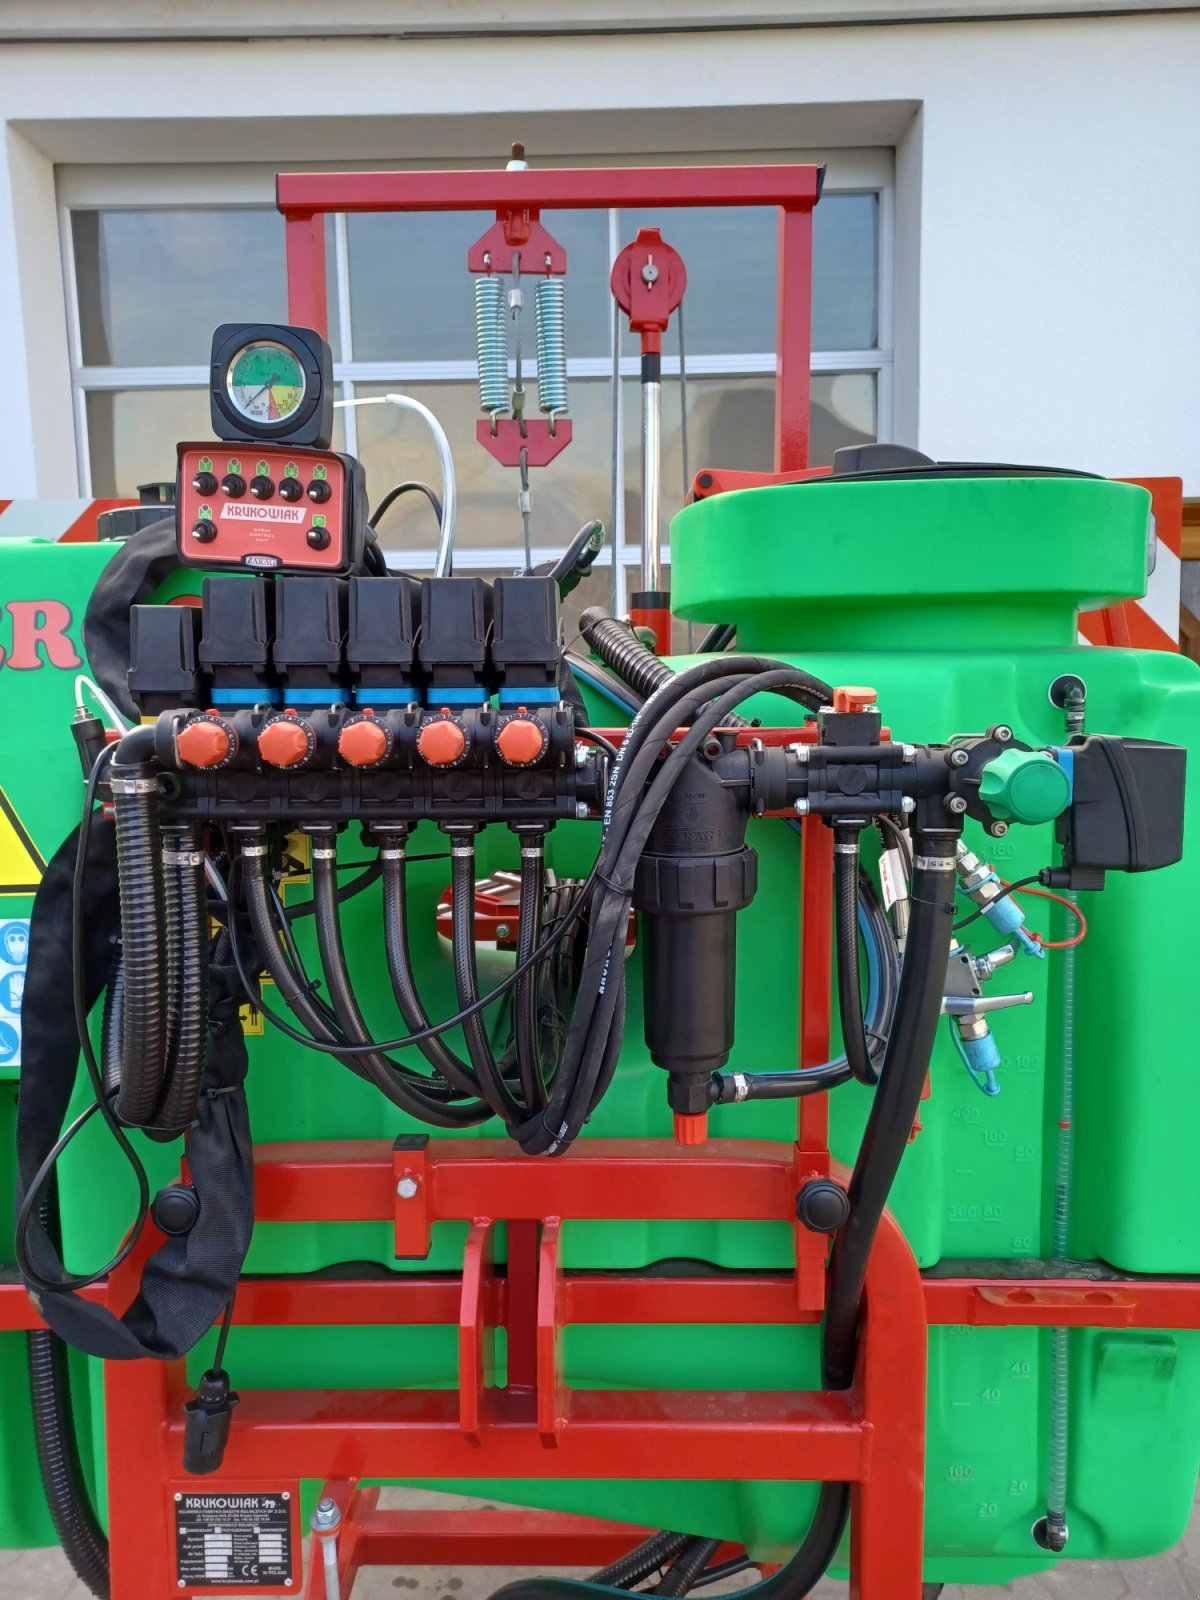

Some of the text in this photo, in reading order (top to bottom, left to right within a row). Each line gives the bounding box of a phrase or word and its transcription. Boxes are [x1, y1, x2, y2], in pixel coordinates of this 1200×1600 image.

[226, 505, 300, 521] KRUKOWIAK
[251, 557, 277, 566] ARAG
[0, 598, 83, 671] R
[622, 739, 630, 747] 6
[615, 747, 627, 761] DN
[609, 766, 621, 786] 2SN
[605, 789, 615, 807] 853
[603, 810, 612, 825] EN
[1016, 1056, 1039, 1068] 100
[951, 1108, 981, 1120] 400
[983, 1130, 1008, 1142] 100
[1015, 1146, 1034, 1158] 80
[949, 1205, 978, 1217] 300
[983, 1205, 1002, 1217] 80
[1012, 1236, 1032, 1248] 60
[1011, 1362, 1031, 1374] 40
[982, 1388, 1001, 1400] 40
[948, 1466, 974, 1477] 100
[1009, 1480, 1028, 1492] 20
[185, 1497, 259, 1509] KRUKOWIAK
[978, 1502, 998, 1514] 20
